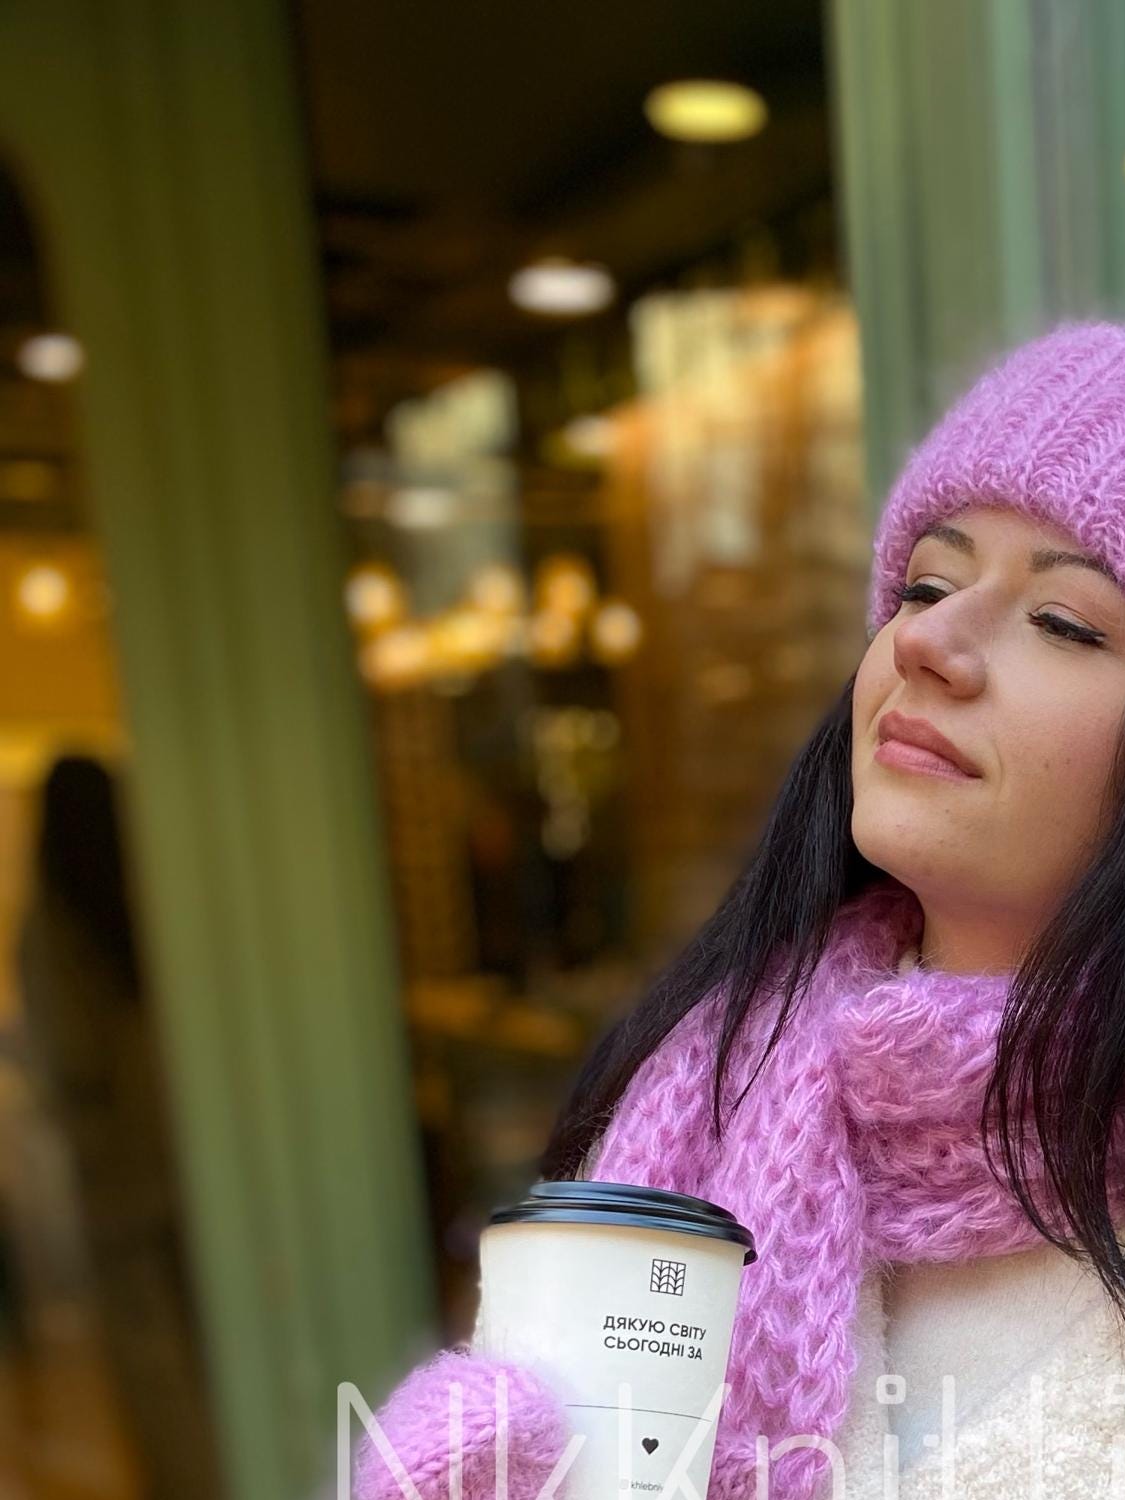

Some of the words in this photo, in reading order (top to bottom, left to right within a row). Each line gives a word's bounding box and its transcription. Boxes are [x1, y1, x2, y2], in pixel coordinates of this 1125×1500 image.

[603, 1315, 665, 1334] ДЯКУЮ
[669, 1323, 707, 1341] СВІТУ
[603, 1335, 685, 1358] СЬОГОДНІ
[687, 1345, 703, 1361] ЗА
